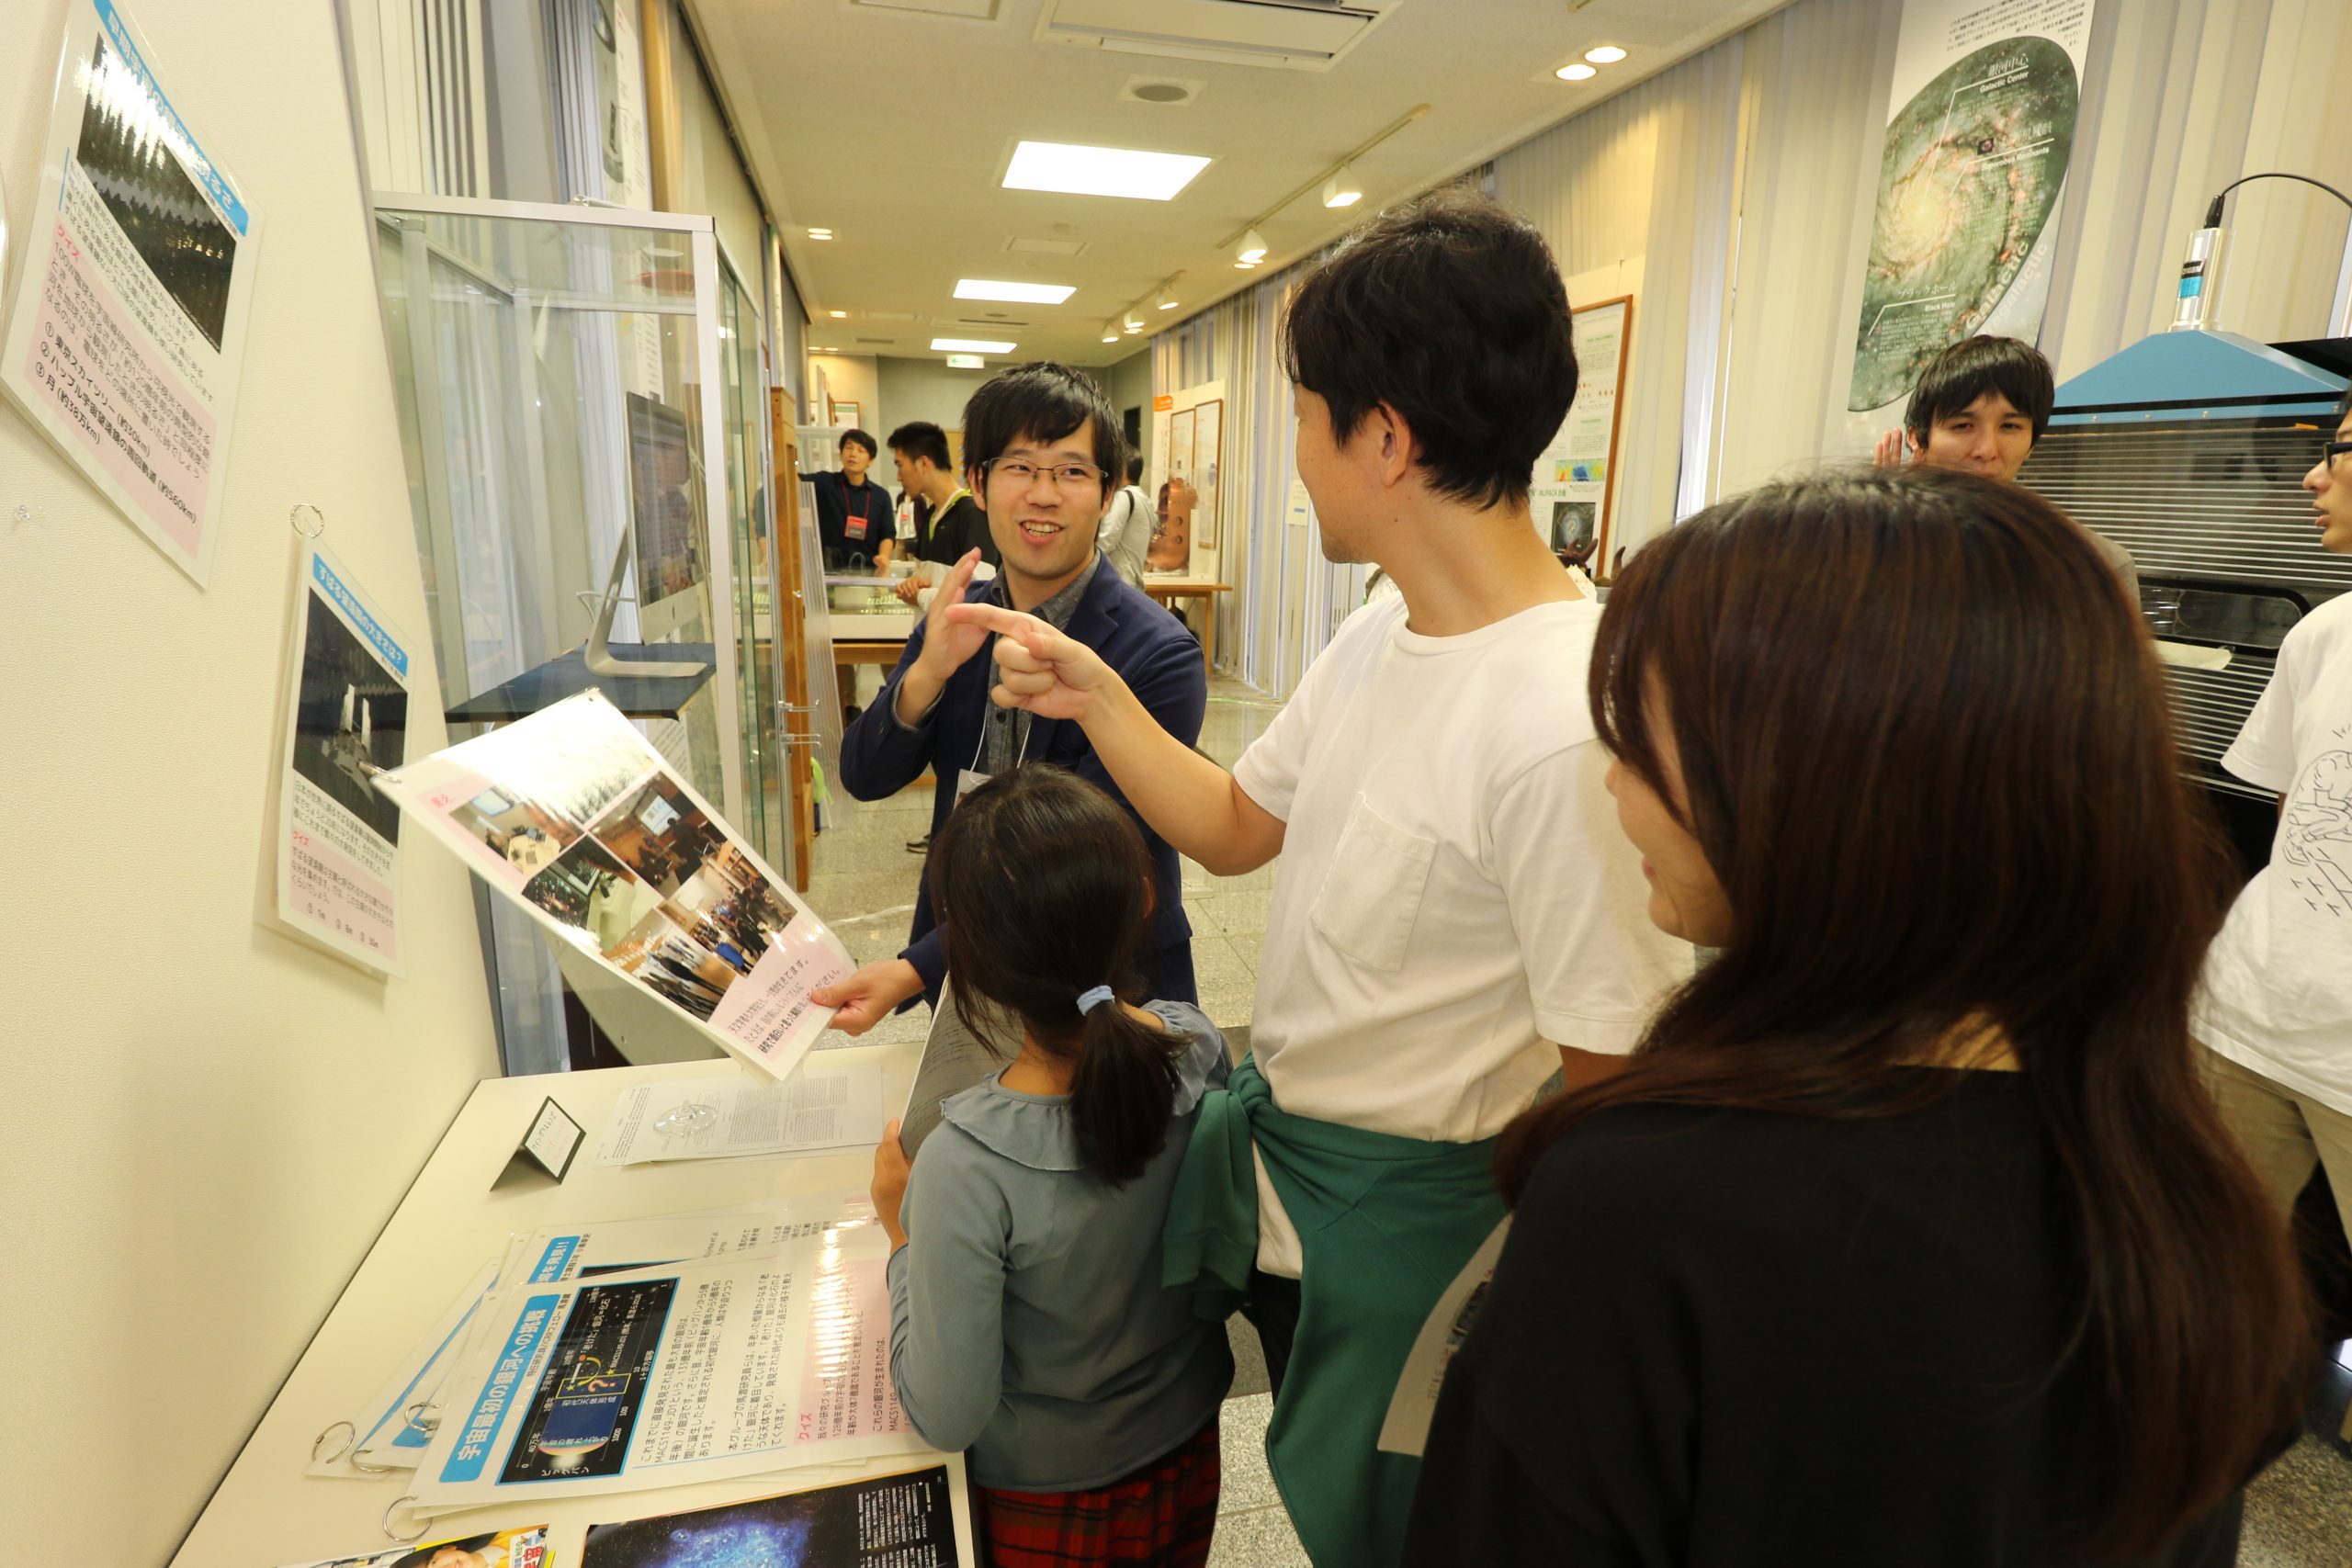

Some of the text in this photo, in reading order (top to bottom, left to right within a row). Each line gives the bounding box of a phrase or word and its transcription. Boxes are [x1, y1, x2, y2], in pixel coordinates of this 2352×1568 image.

[1980, 72, 2029, 93] Galactic Center
[2017, 147, 2050, 161] Remnants
[56, 221, 81, 265] クイズ
[1965, 242, 2029, 330] Galactic
[43, 370, 56, 395] 月
[53, 332, 117, 420] 東京スカイツリー
[292, 828, 310, 848] クイズ
[454, 1307, 548, 1461] 宇宙最初の銀河への挑戦
[618, 1404, 629, 1416] 100
[632, 1365, 641, 1373] 10
[872, 1336, 886, 1432] これらの銀河が生まれたのは、
[525, 1431, 542, 1453] 40万年
[697, 1418, 717, 1457] あります。
[770, 1401, 786, 1446] てくれます。
[797, 1411, 812, 1440] クイズ
